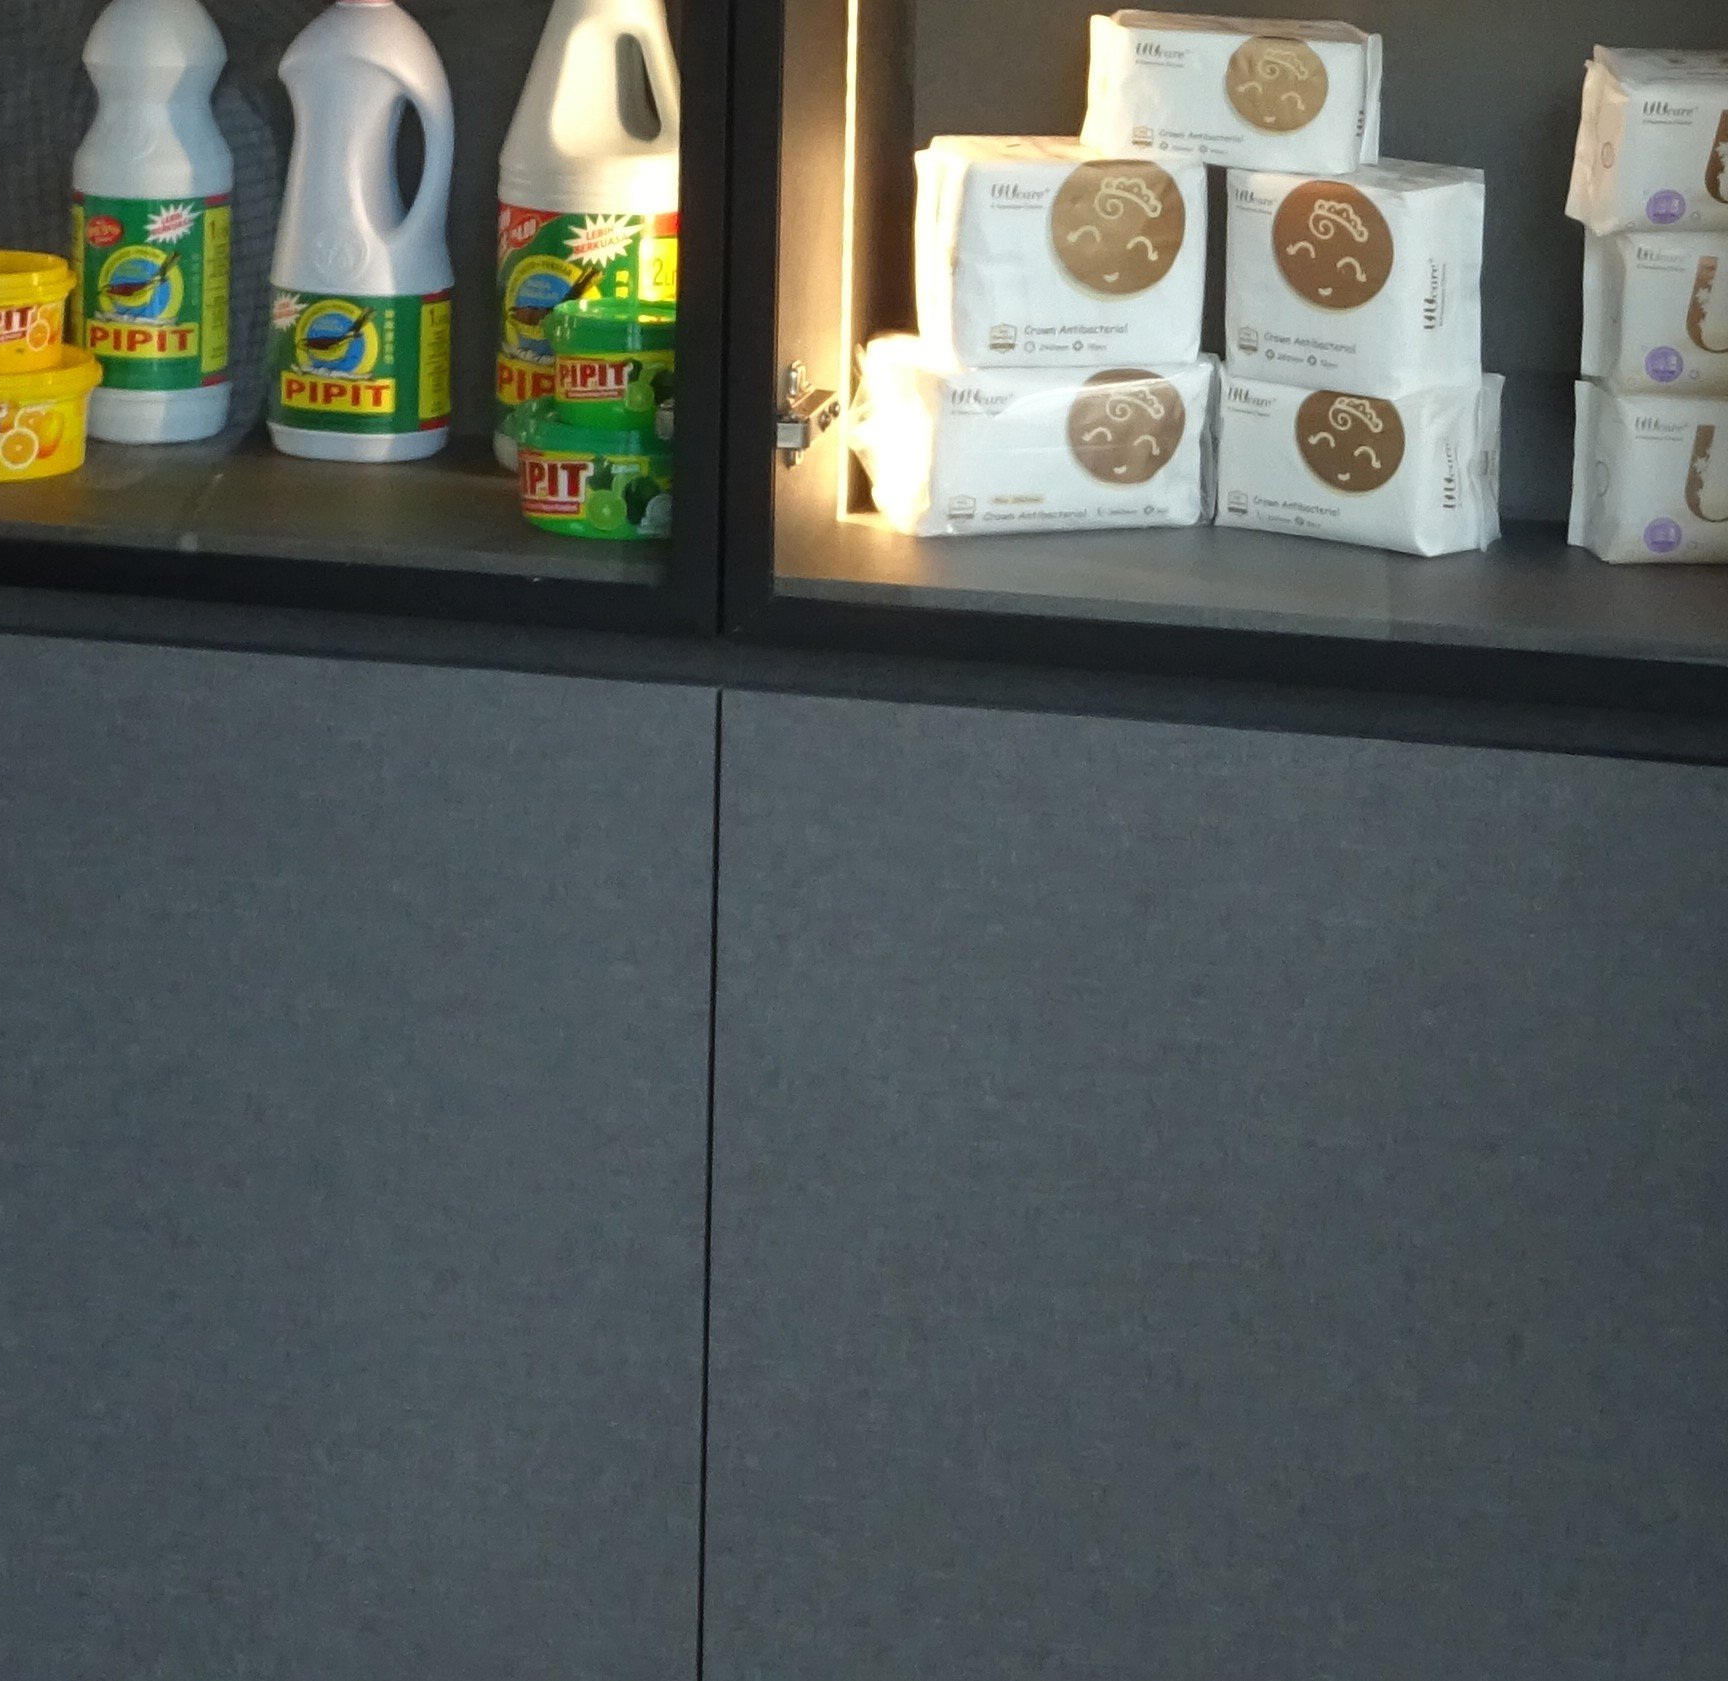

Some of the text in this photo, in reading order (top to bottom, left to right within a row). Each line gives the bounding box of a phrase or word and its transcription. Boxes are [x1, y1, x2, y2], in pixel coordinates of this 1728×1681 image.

[585, 226, 615, 241] LEBIH
[90, 326, 195, 353] PIPIT
[1060, 323, 1129, 336] Antibacterial
[1294, 334, 1357, 354] Antibacterial
[559, 362, 628, 388] PIPIT
[285, 378, 391, 408] PIPIT
